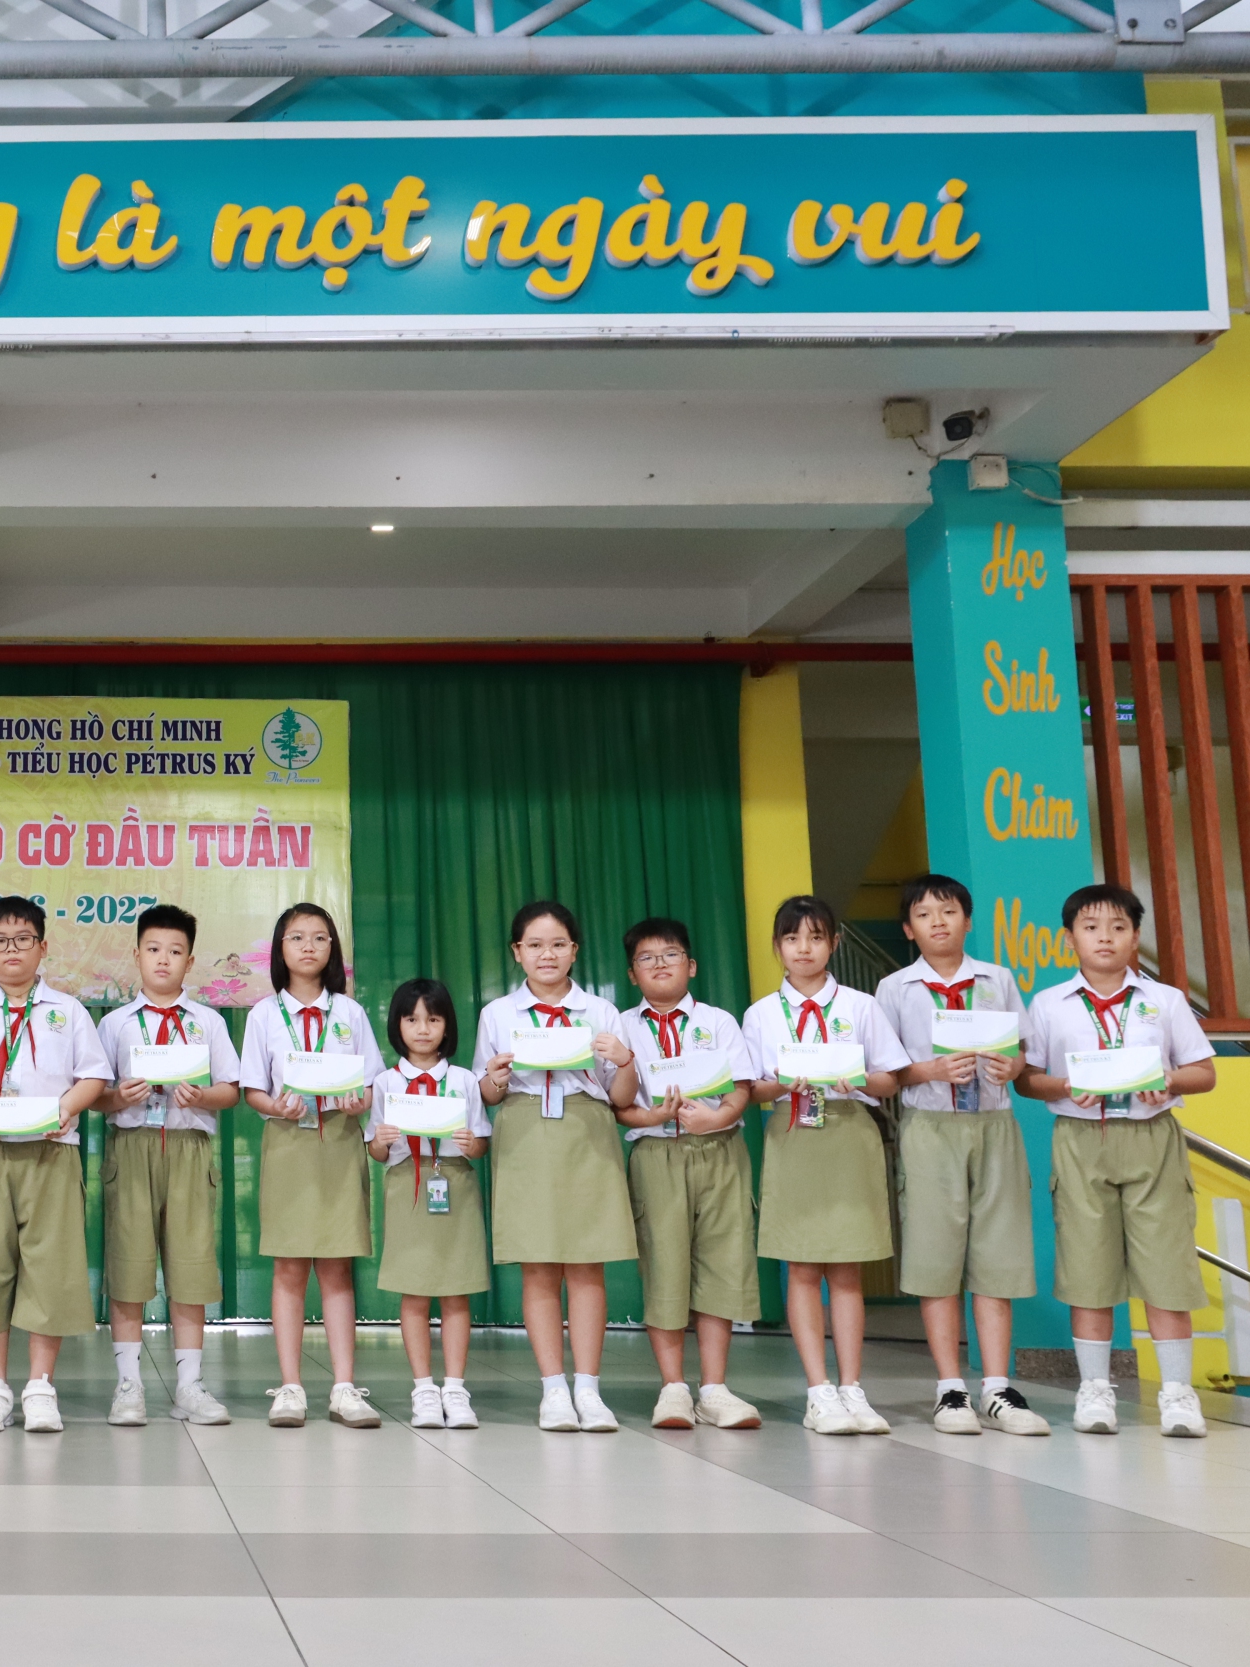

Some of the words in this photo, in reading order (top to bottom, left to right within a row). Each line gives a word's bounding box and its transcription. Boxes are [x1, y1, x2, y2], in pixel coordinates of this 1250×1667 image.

[57, 174, 178, 270] là
[212, 177, 431, 290] một
[466, 175, 775, 298] ngày
[790, 179, 980, 265] vui
[981, 521, 1047, 601] Học
[983, 640, 1060, 715] Sinh
[7, 742, 61, 774] TIỂU
[68, 752, 118, 779] HỌC
[125, 746, 216, 775] PÉTRUS
[223, 747, 256, 775] KÝ
[70, 711, 104, 741] HỒ
[111, 712, 155, 742] CHÍ
[160, 719, 222, 742] MINH
[18, 813, 77, 866] CỜ
[86, 806, 176, 867] ĐẦU
[188, 806, 312, 868] TUẦN
[983, 767, 1079, 842] Chăm
